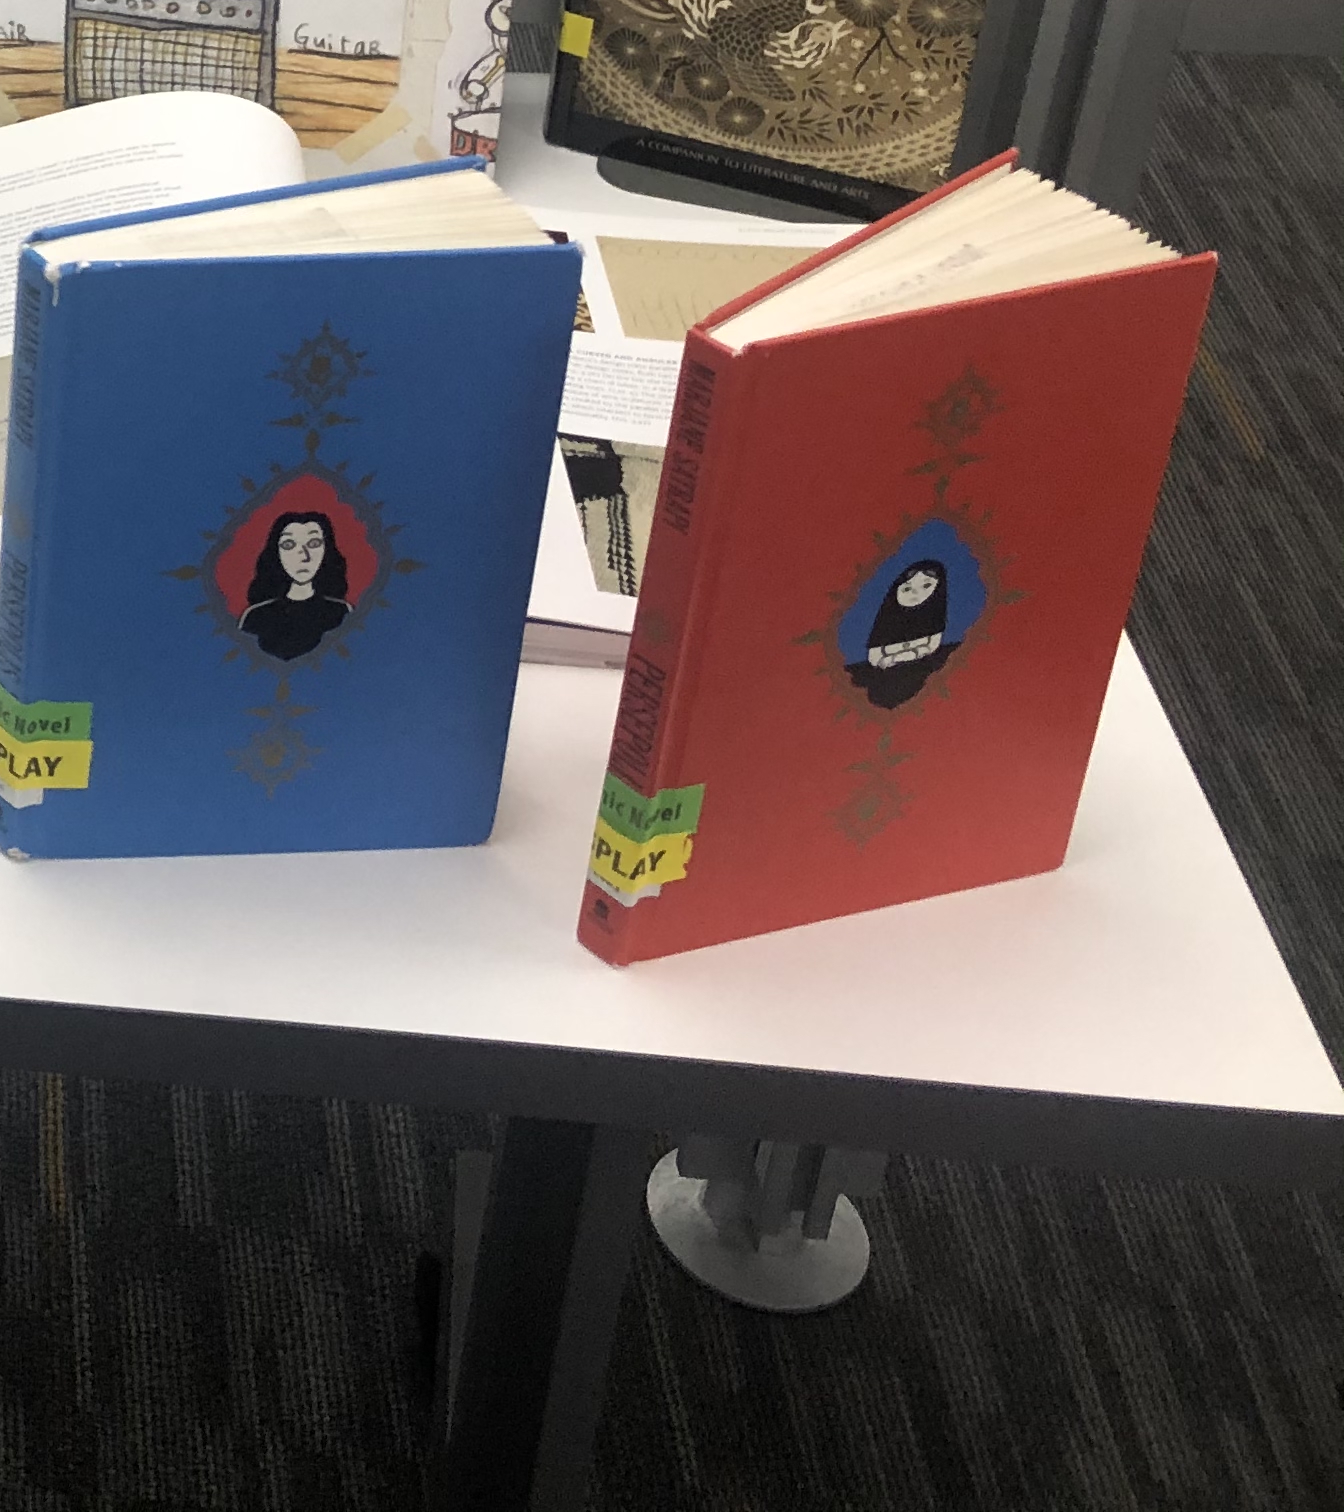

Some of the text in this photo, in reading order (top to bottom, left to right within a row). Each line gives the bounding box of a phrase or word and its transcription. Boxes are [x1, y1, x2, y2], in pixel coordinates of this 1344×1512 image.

[635, 138, 871, 201] A COMPANION TO LITERATURE AND ARTS
